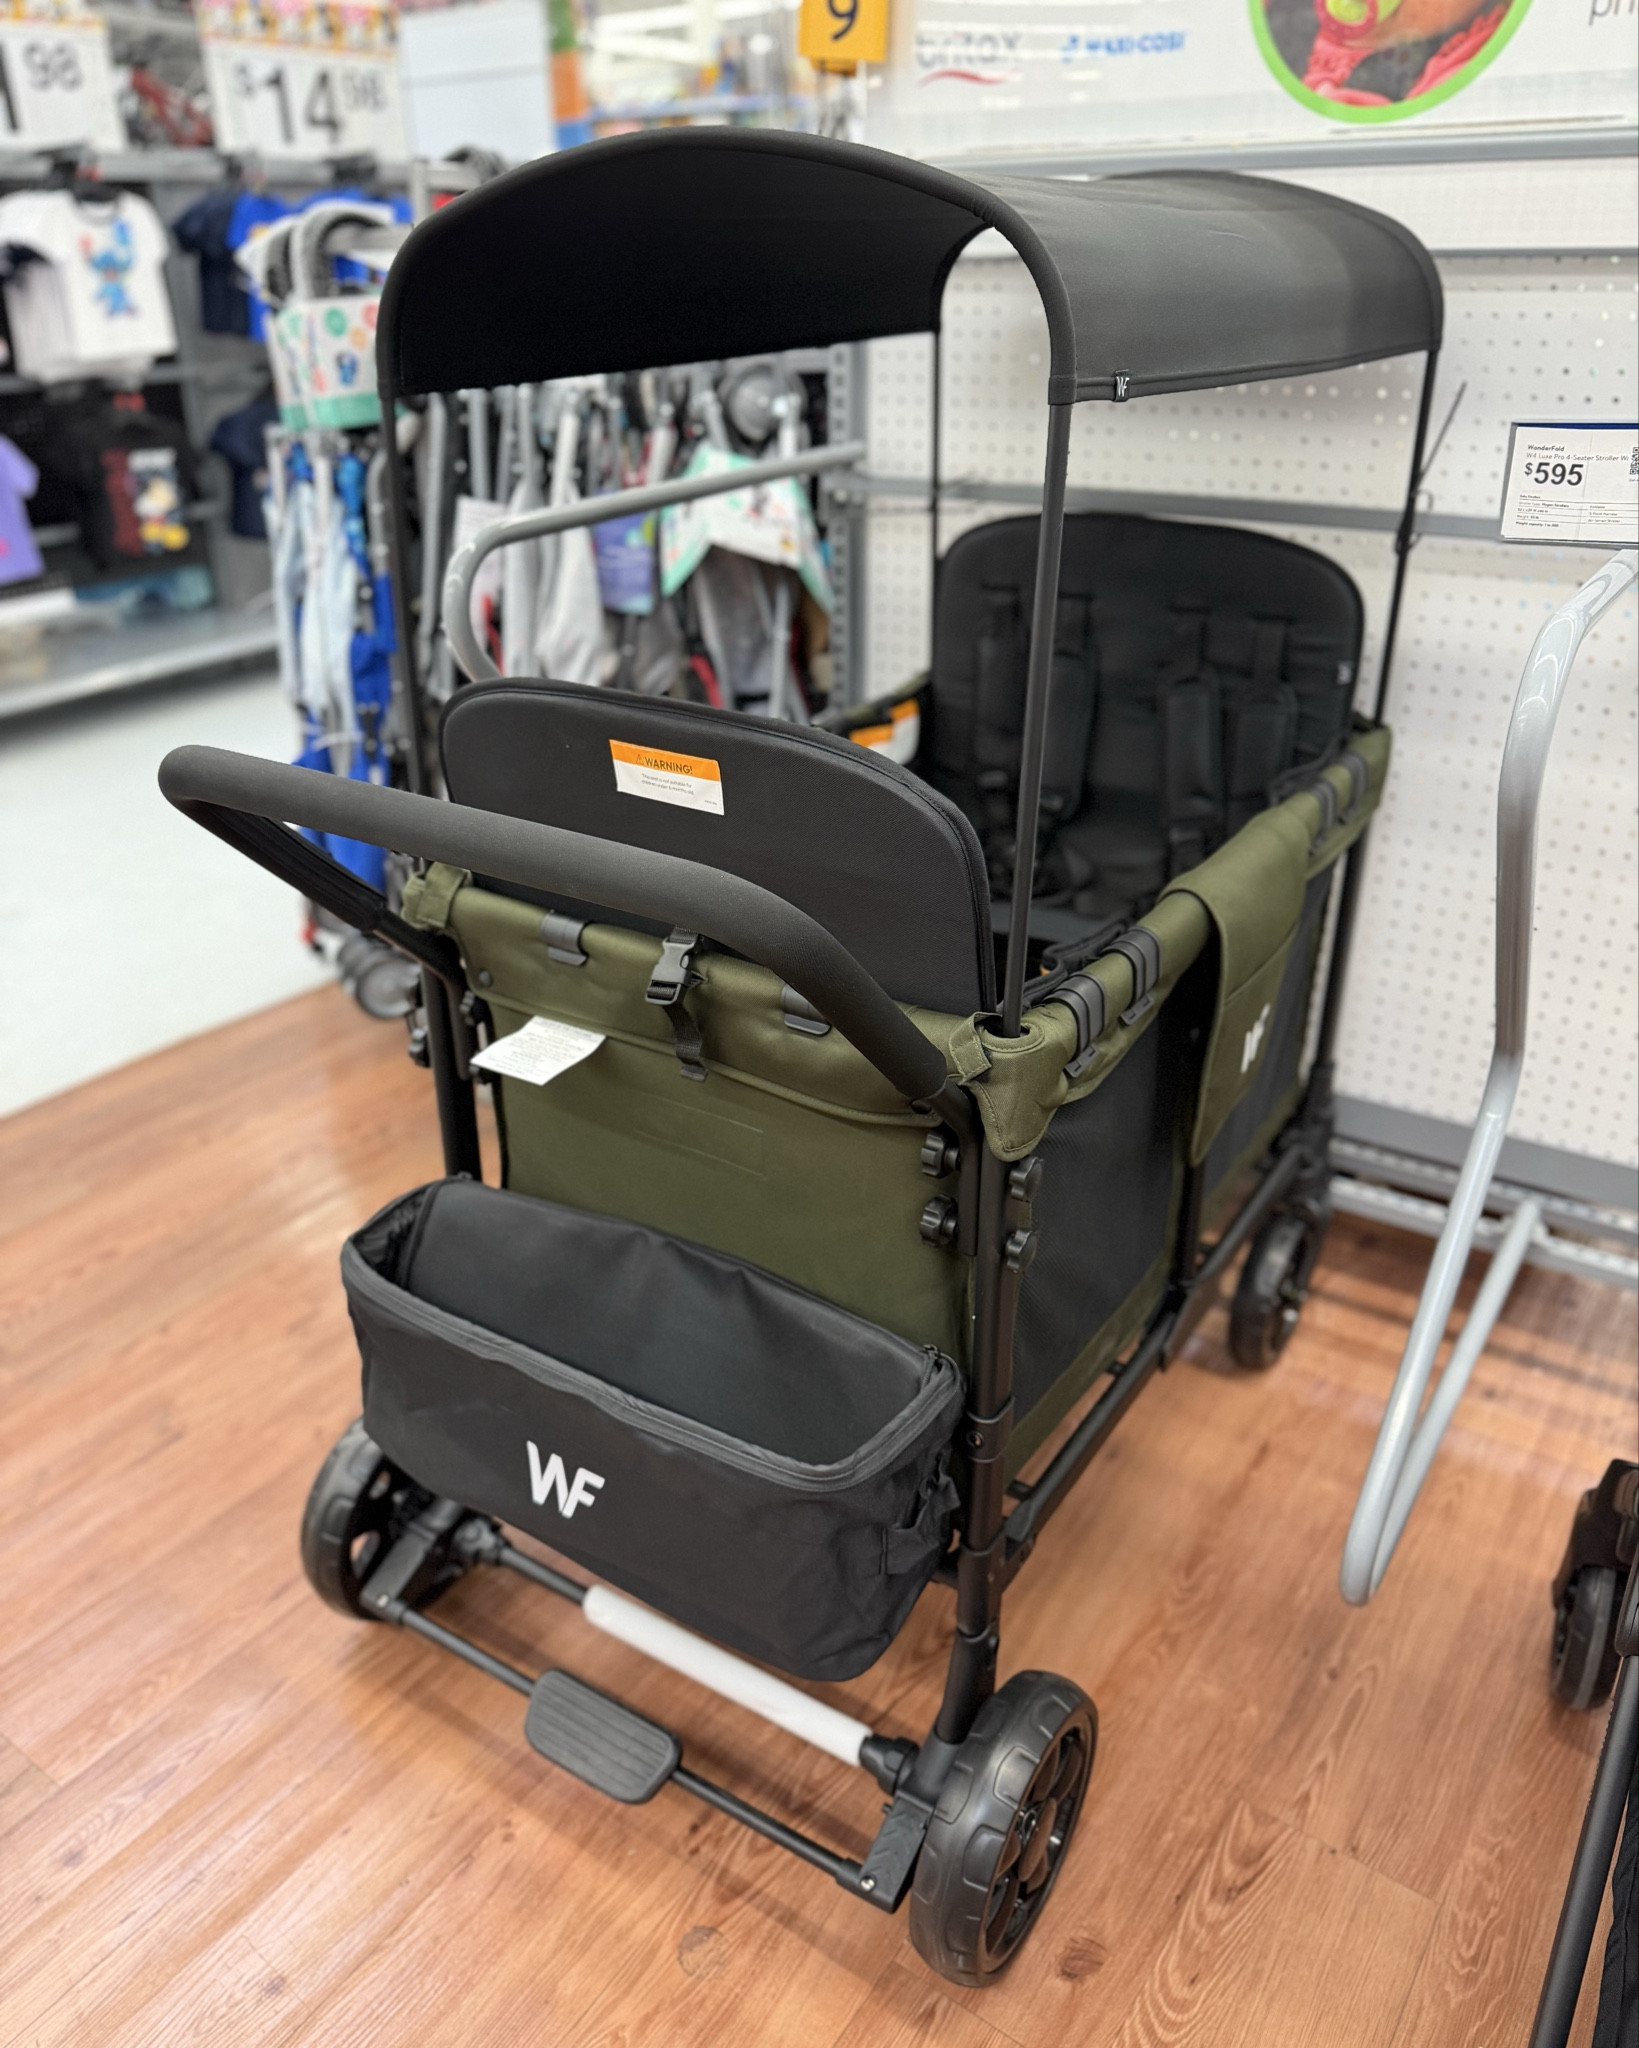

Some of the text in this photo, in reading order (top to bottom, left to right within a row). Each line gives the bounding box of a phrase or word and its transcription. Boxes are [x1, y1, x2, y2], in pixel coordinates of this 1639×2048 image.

[828, 0, 860, 42] 9
[1527, 444, 1565, 452] WonderFold
[1524, 462, 1584, 486] $595
[644, 757, 693, 775] WARNING!
[526, 1440, 606, 1519] WF
